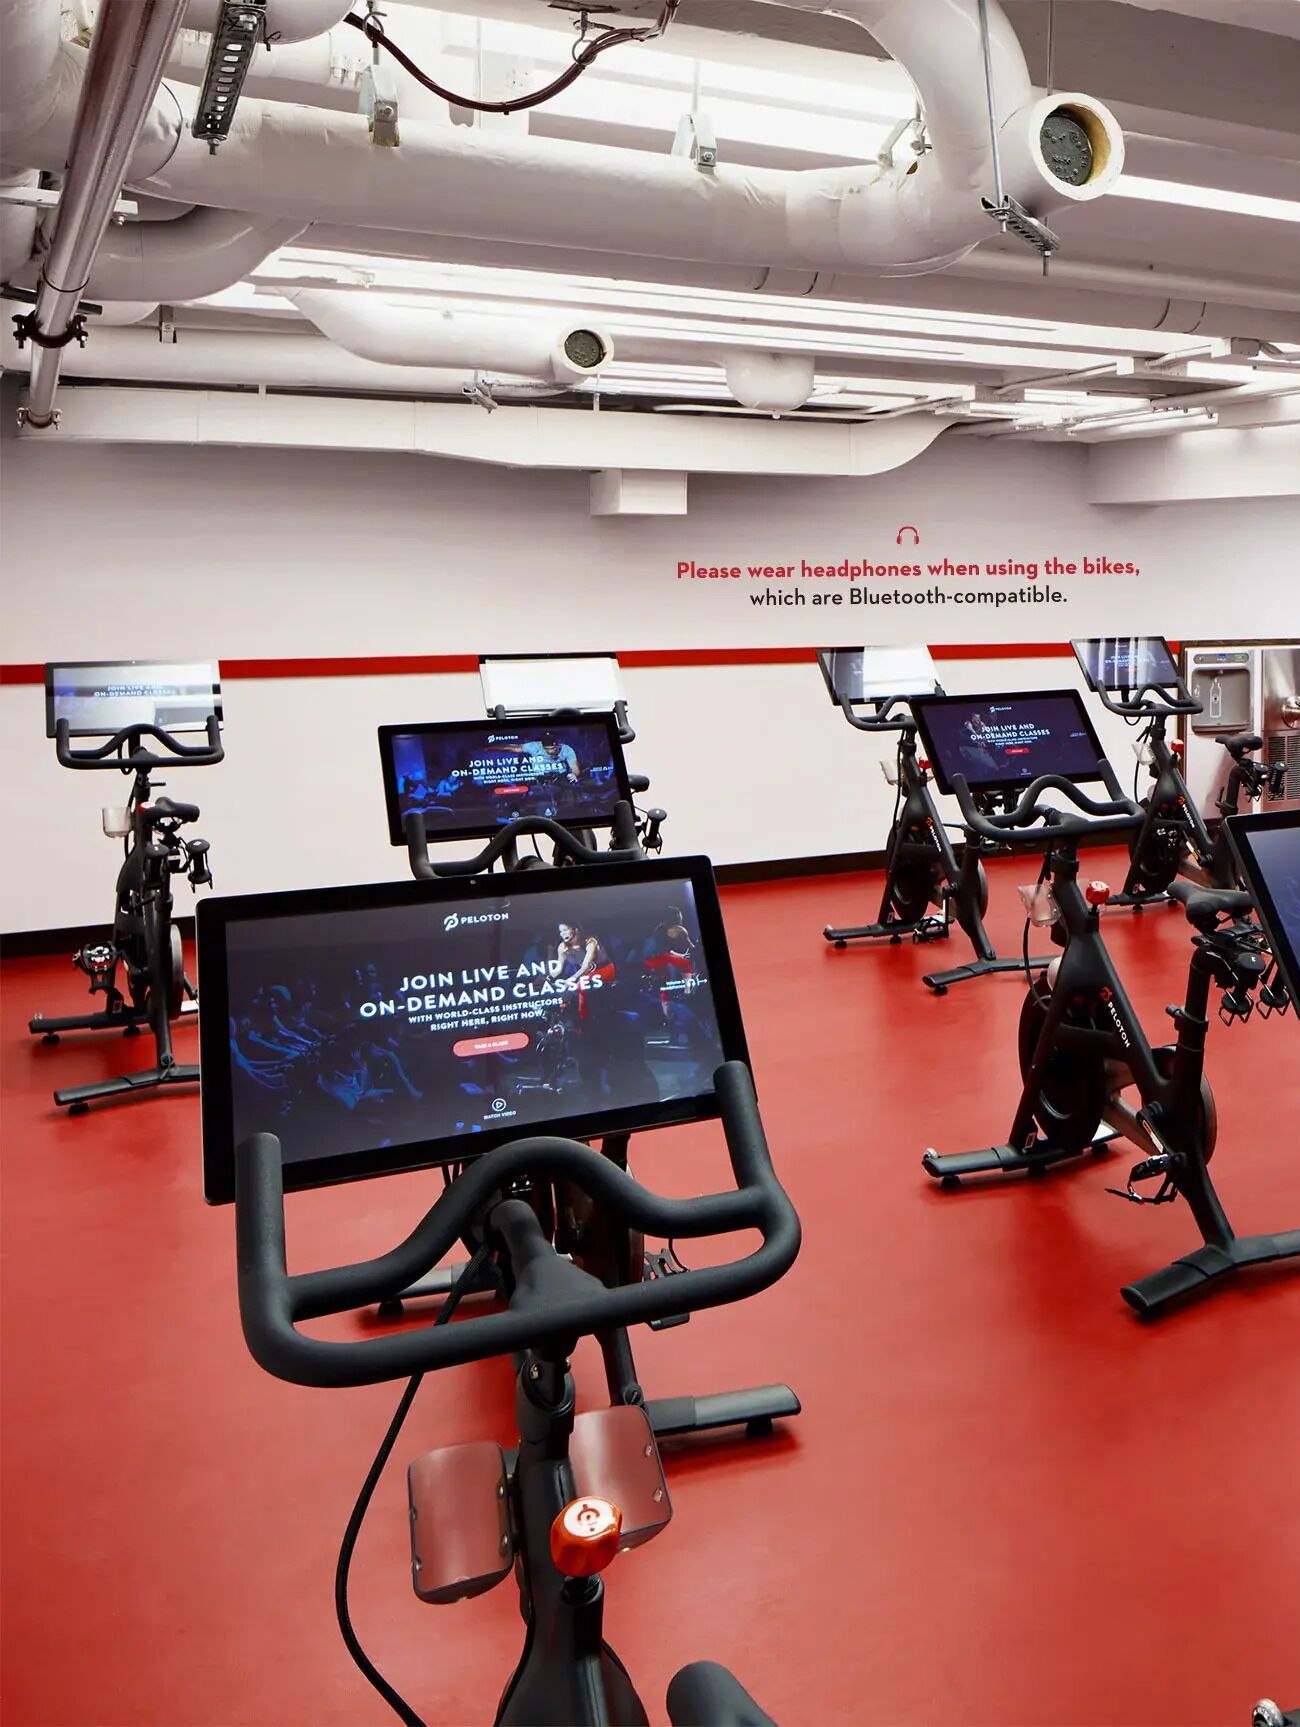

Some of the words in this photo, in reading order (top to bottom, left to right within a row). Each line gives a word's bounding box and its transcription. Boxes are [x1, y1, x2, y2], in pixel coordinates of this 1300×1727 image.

[676, 561, 741, 579] Please
[747, 565, 795, 578] wear
[801, 559, 922, 581] headphones
[927, 557, 980, 577] when
[985, 559, 1038, 580] using
[1044, 557, 1078, 576] the
[1082, 557, 1140, 578] bikes,
[750, 589, 806, 606] which
[811, 593, 843, 606] are
[849, 586, 1068, 607] Bluetooth-compatible.
[970, 732, 1018, 741] ON-DEMAND
[1019, 729, 1050, 737] CLASSES
[451, 766, 518, 777] ON-DEMAND
[520, 762, 564, 773] CLASSES
[469, 759, 494, 768] JOIN
[497, 757, 519, 766] LIVE
[521, 755, 544, 764] AND
[461, 913, 509, 925] PELOTON
[400, 972, 453, 992] JOIN
[462, 965, 509, 985] LIVE
[516, 959, 561, 978] AND
[360, 986, 505, 1017] ON-DEMAND
[513, 974, 603, 998] CLASSES
[408, 1014, 432, 1024] WITH
[435, 1006, 500, 1020] WORLD-CLASS
[502, 997, 563, 1012] INSTRUCTORS
[430, 1020, 459, 1032] RIGHT
[461, 1016, 489, 1027] HERE,
[491, 1011, 518, 1023] RIGHT
[1107, 1001, 1131, 1048] PELOTON
